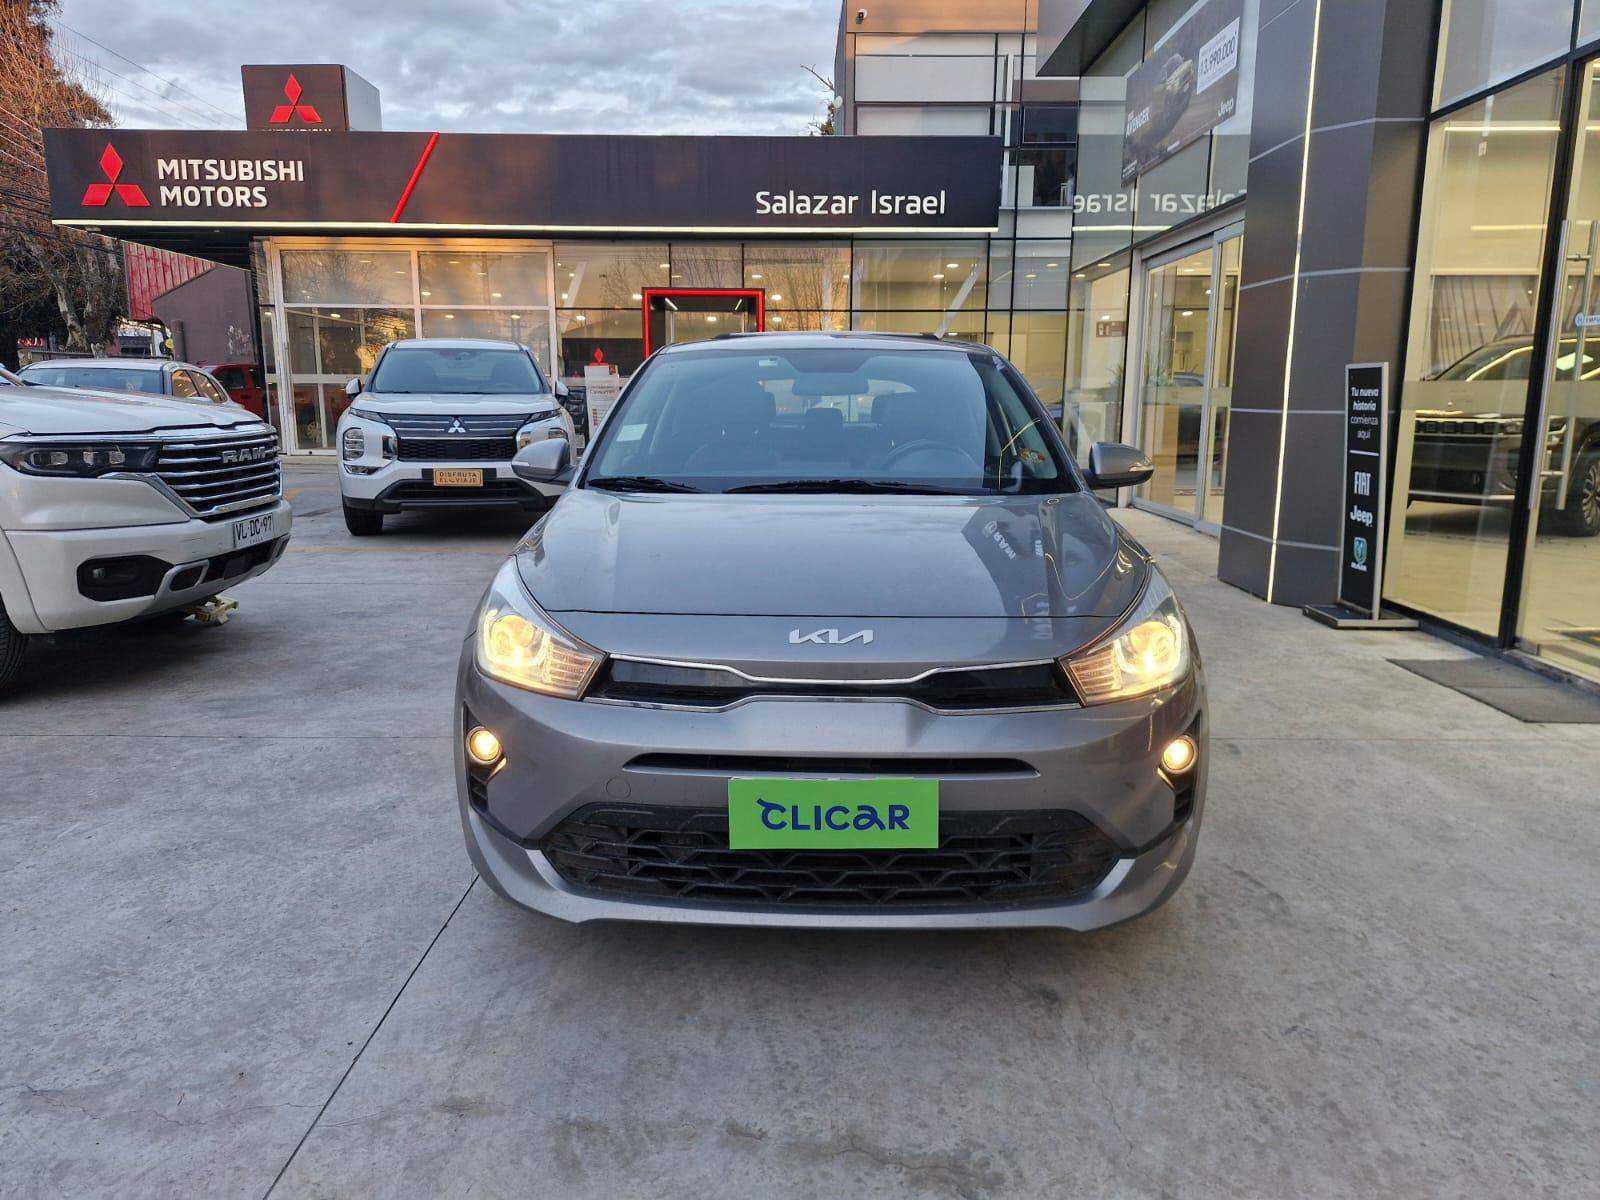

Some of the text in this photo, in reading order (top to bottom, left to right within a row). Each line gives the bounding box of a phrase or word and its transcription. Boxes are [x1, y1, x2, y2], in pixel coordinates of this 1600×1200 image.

[157, 158, 305, 182] MITSUBISHI
[159, 185, 268, 207] MOTORS
[755, 190, 946, 215] Salazar Israel
[1351, 386, 1379, 397] Tu nueva
[1352, 399, 1377, 411] historia
[1350, 414, 1379, 426] comienza
[222, 446, 267, 464] RAM
[1353, 471, 1371, 496] FIAT
[1350, 505, 1373, 527] Jeep
[788, 628, 875, 646] KIA
